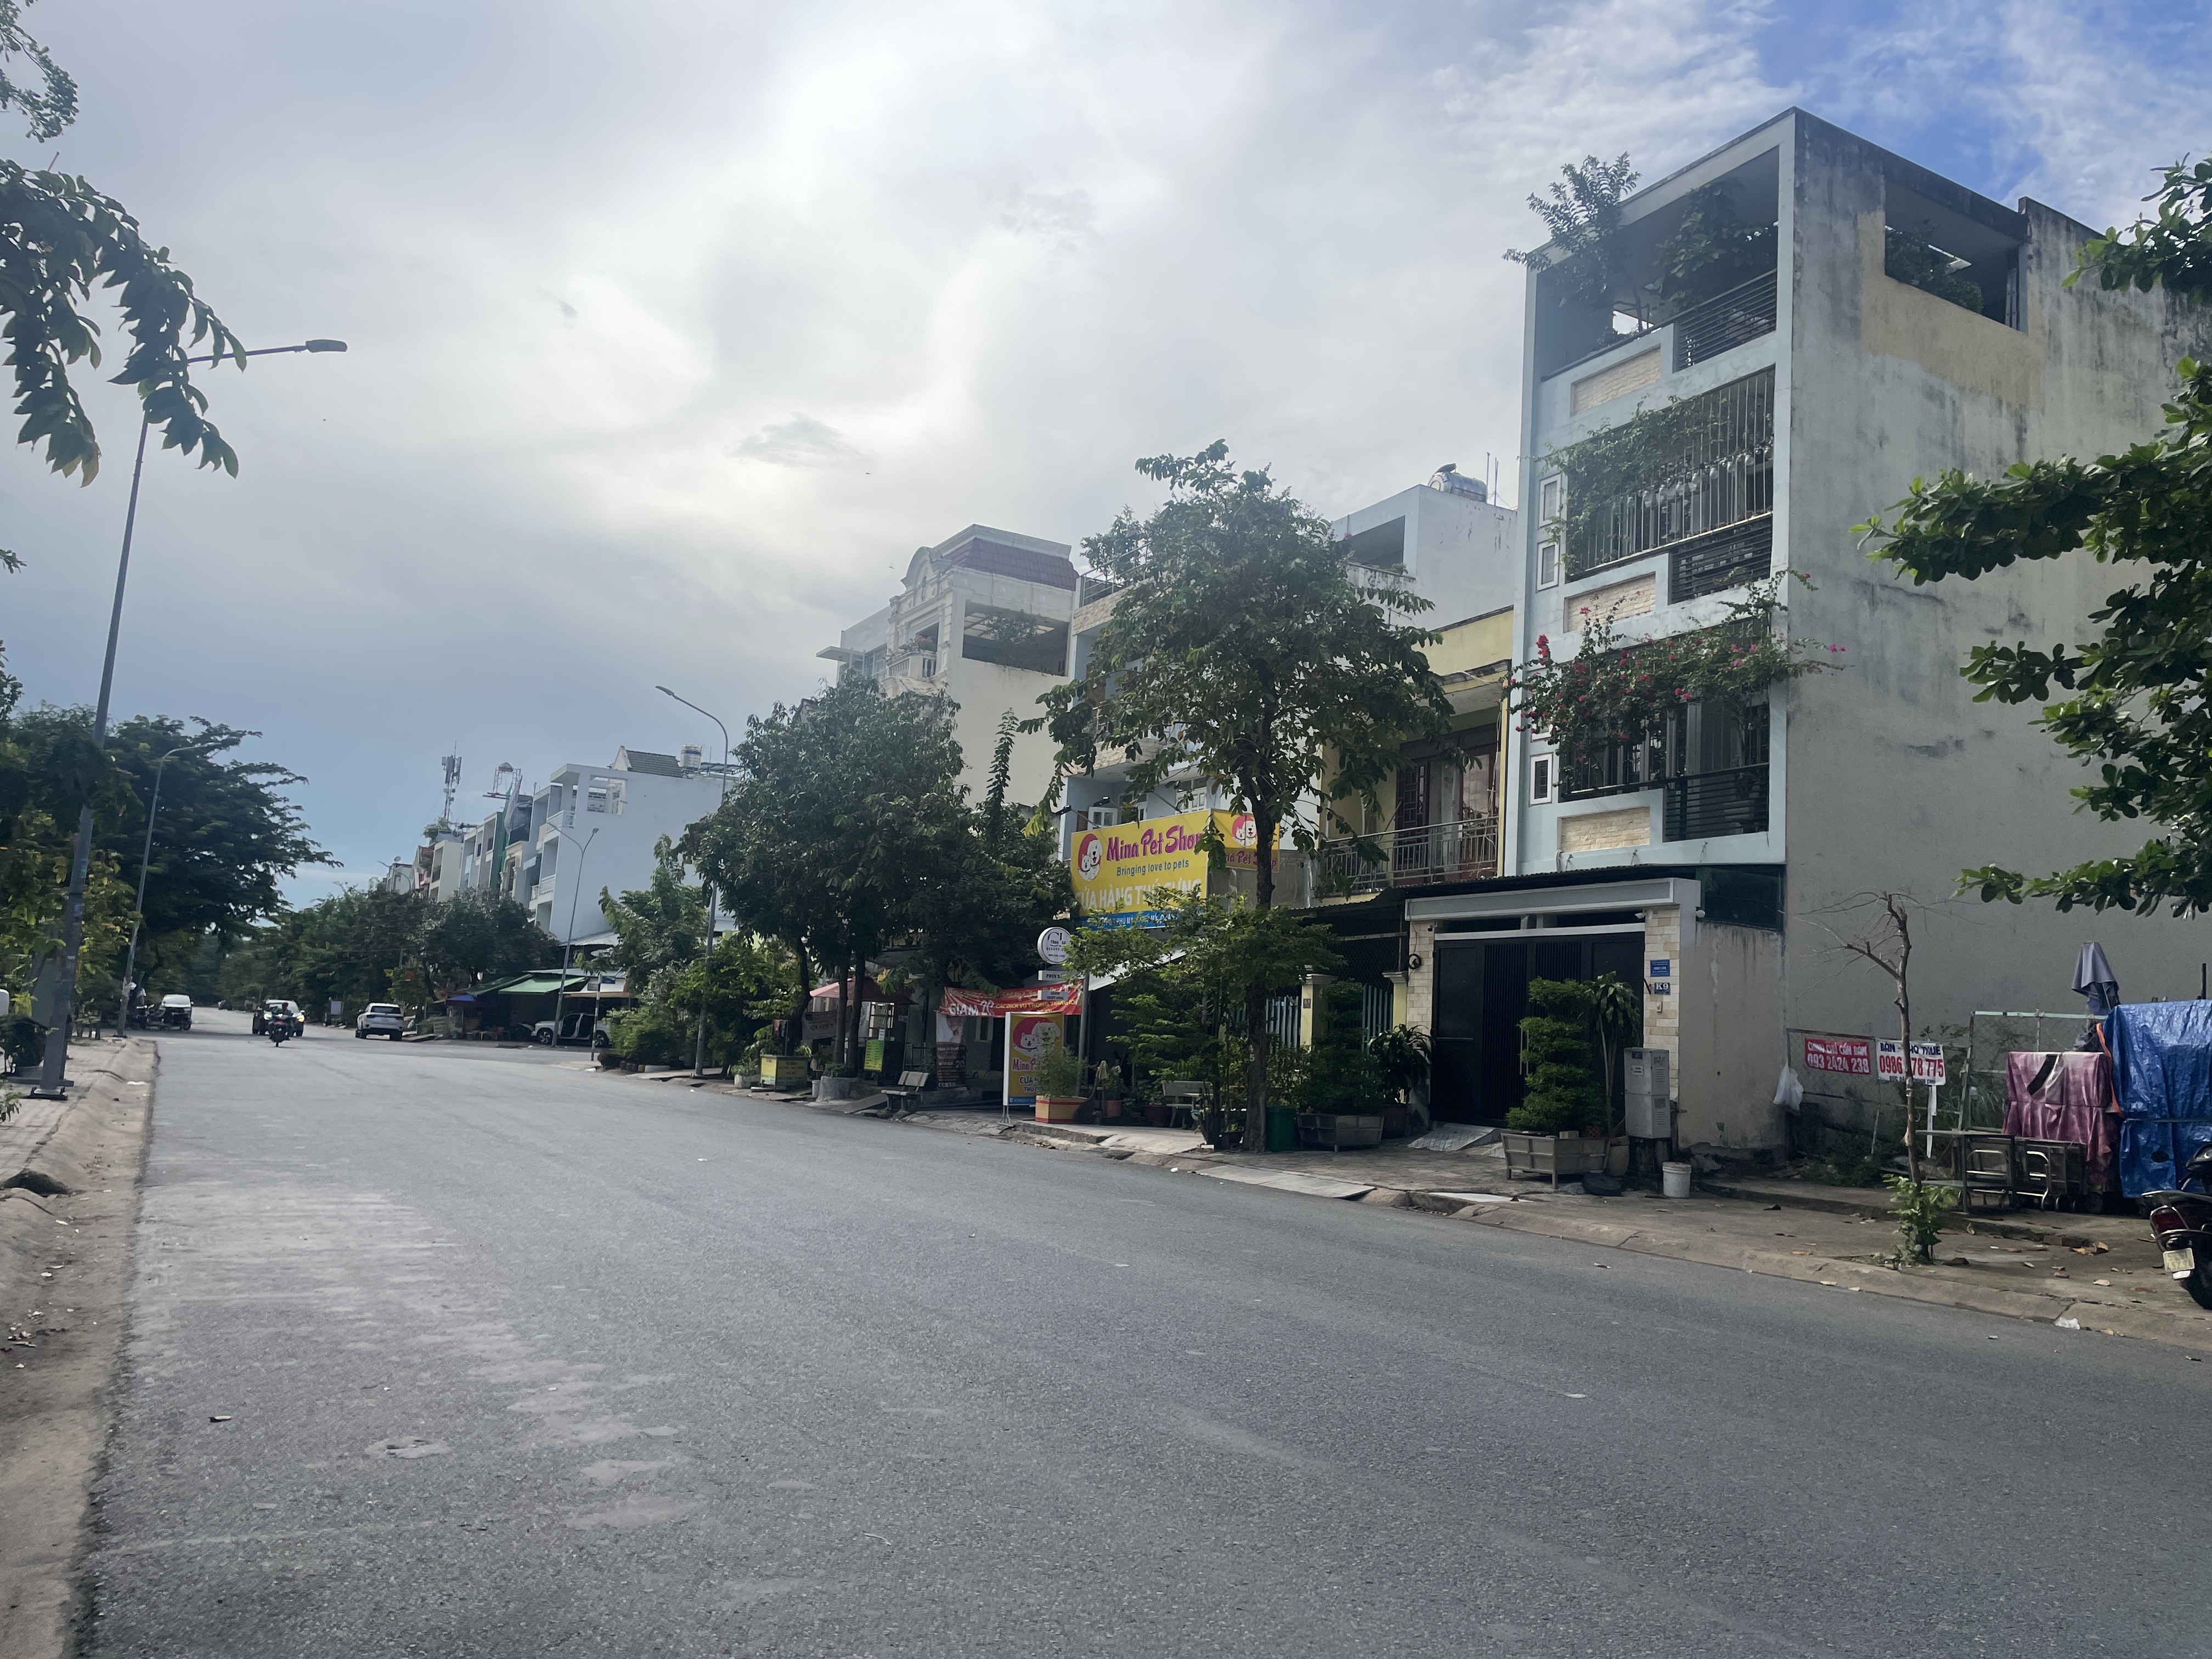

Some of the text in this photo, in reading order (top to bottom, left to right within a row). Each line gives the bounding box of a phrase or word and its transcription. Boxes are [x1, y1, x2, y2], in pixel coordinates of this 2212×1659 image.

[1106, 835, 1139, 861] Mina
[1141, 828, 1164, 856] Pet
[1117, 859, 1189, 877] Bringing love to pets
[1237, 850, 1251, 865] Pet
[1252, 851, 1277, 869] Sp
[1012, 1058, 1029, 1071] Mina
[1807, 1053, 1870, 1073] 093 2424 238
[1879, 1055, 1944, 1077] 0986 78 775
